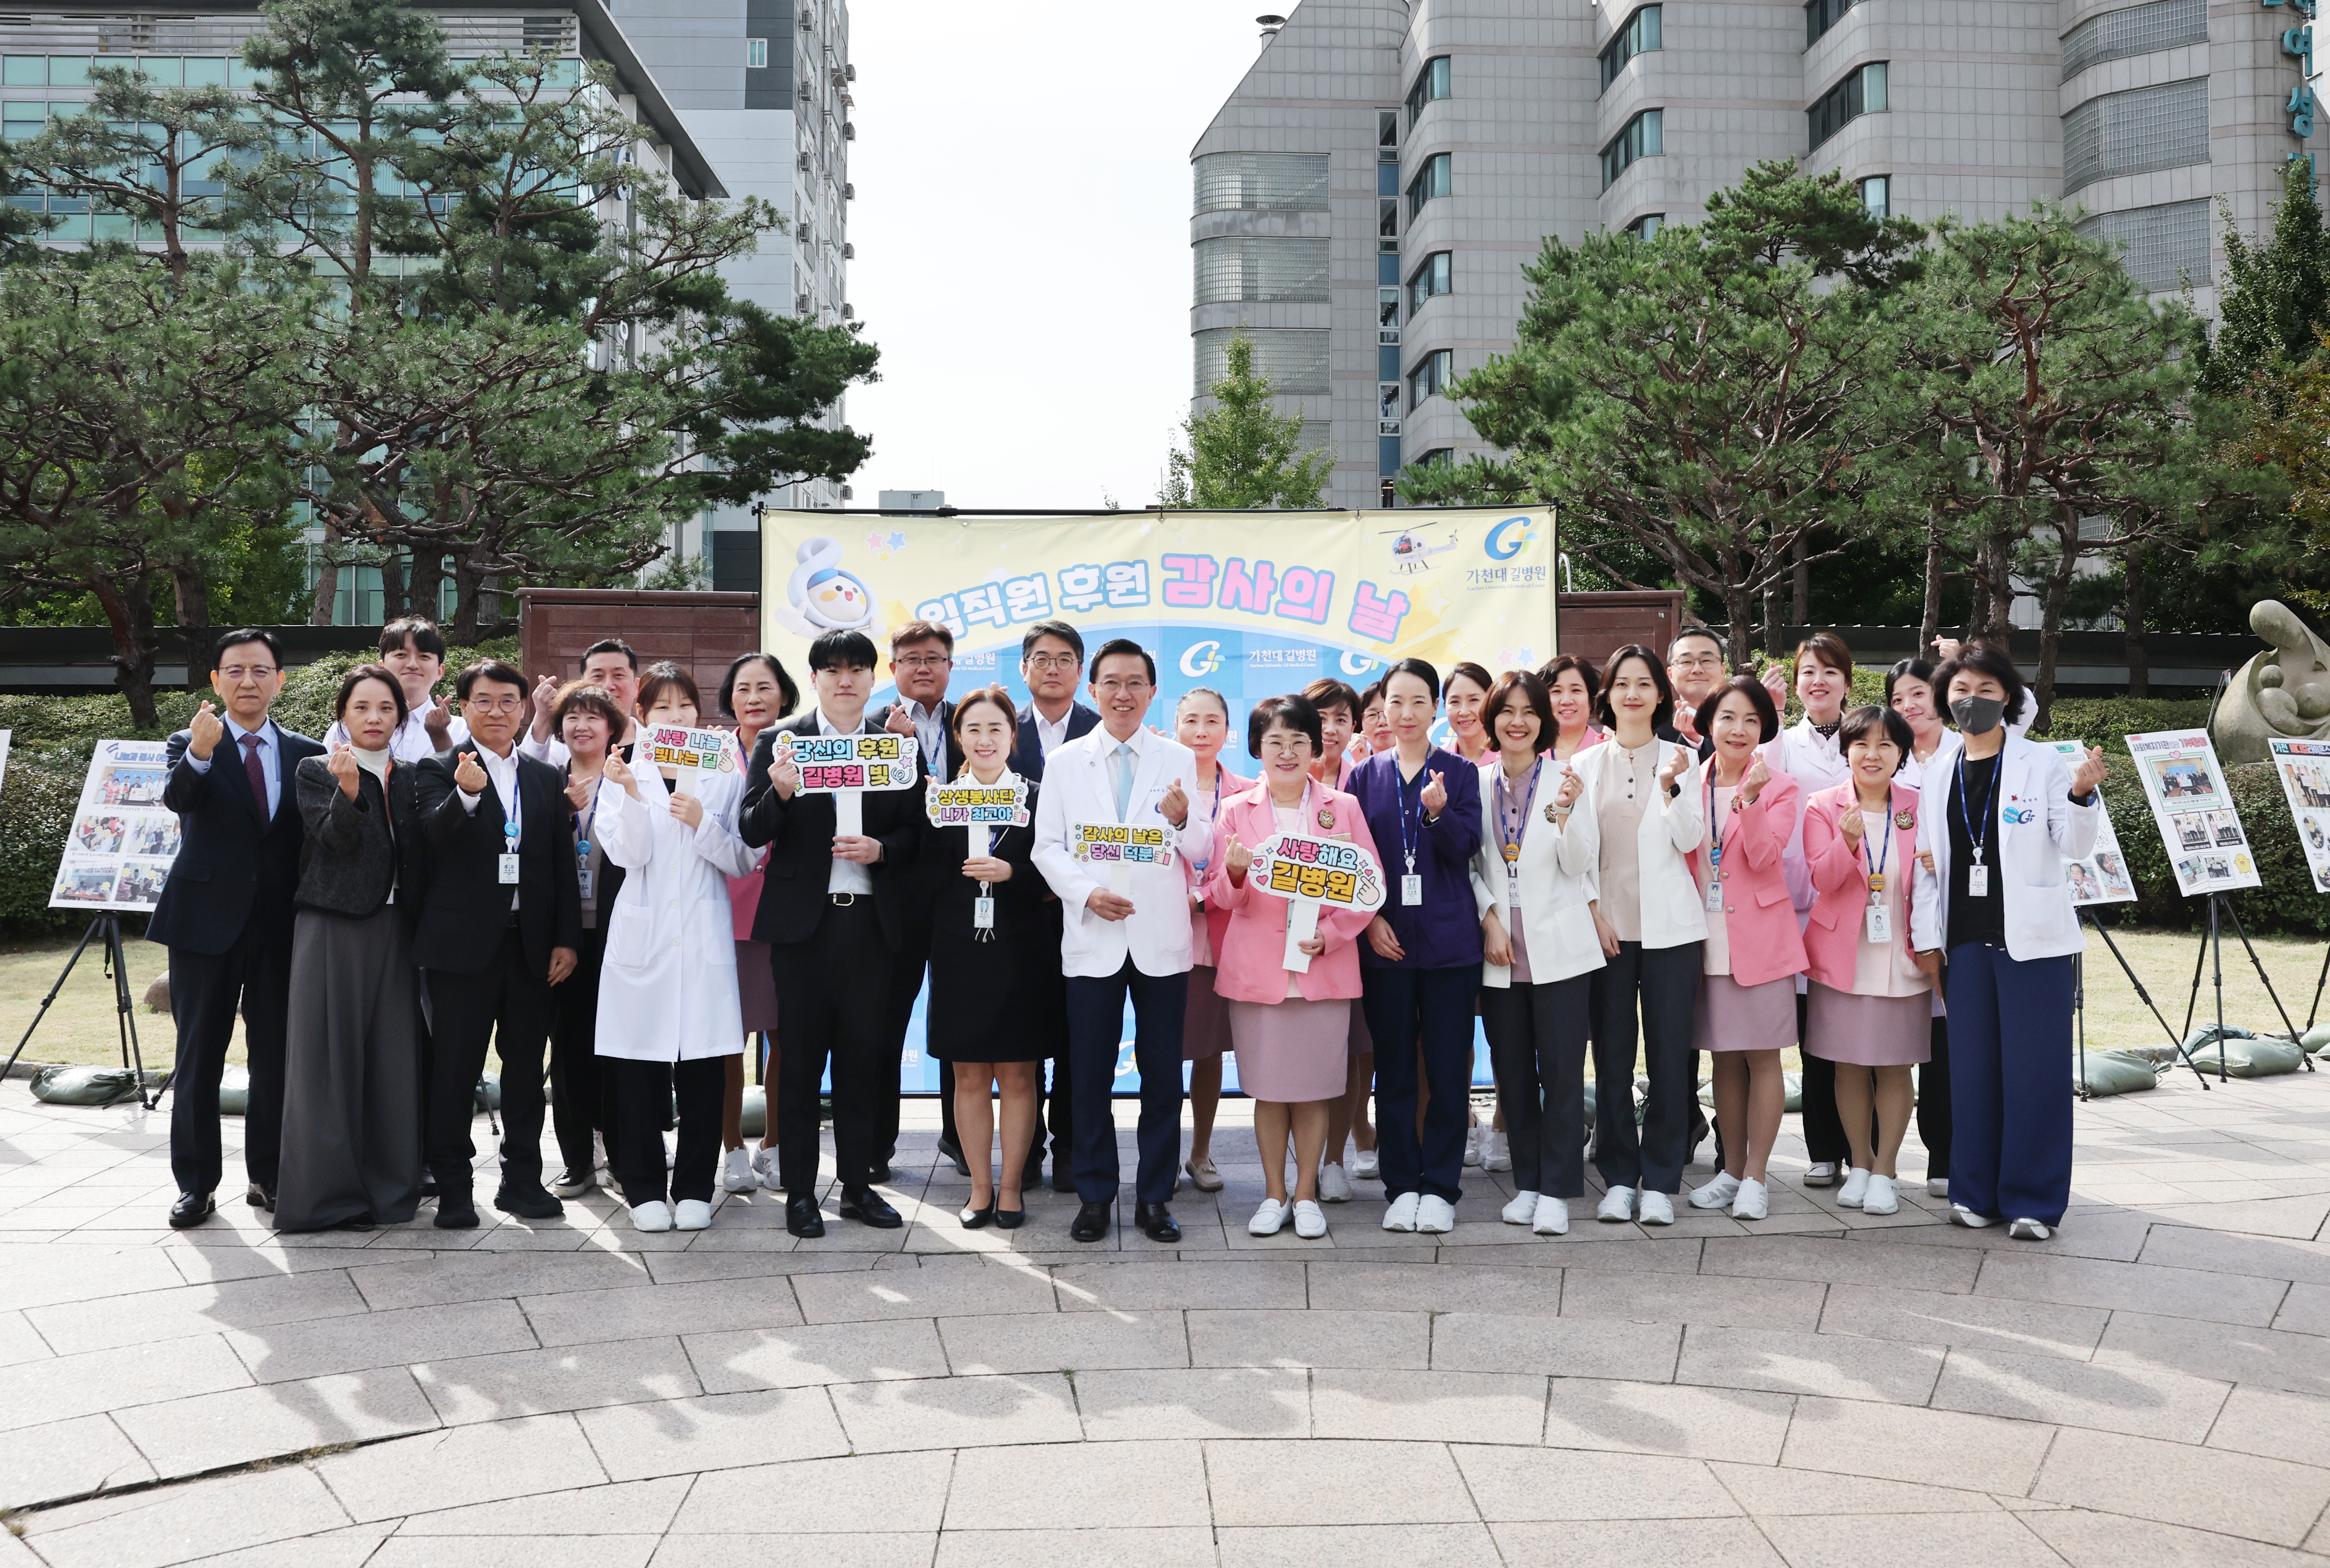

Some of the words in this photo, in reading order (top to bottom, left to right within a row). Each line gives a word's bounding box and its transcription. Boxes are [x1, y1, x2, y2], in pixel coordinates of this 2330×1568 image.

[1467, 567, 1507, 583] 가천대
[1510, 566, 1546, 582] 길병원
[917, 573, 1053, 639] 임직원
[1058, 559, 1150, 613] 후원
[1161, 554, 1335, 625] 감사의
[1348, 580, 1411, 643] 날
[1249, 650, 1282, 662] 가천대
[1285, 649, 1316, 661] 길병원
[655, 729, 687, 747] 사랑
[690, 733, 721, 751] 나눔
[2273, 743, 2289, 753] 가천
[139, 752, 155, 761] 봉사
[654, 747, 698, 766] 빛나는
[702, 753, 718, 769] 길
[791, 739, 852, 762] 당신의
[858, 738, 899, 759] 후원
[803, 765, 863, 788] 길병원
[869, 765, 890, 786] 빛
[939, 789, 1015, 805] 상생봉사단
[942, 807, 968, 821] 니가
[971, 807, 1012, 821] 최고야
[1083, 826, 1129, 843] 감사의
[1132, 829, 1162, 845] 날은
[1091, 844, 1120, 860] 당신
[1124, 846, 1153, 862] 덕분
[1277, 838, 1357, 870] 사랑해요
[1271, 861, 1356, 903] 길병원
